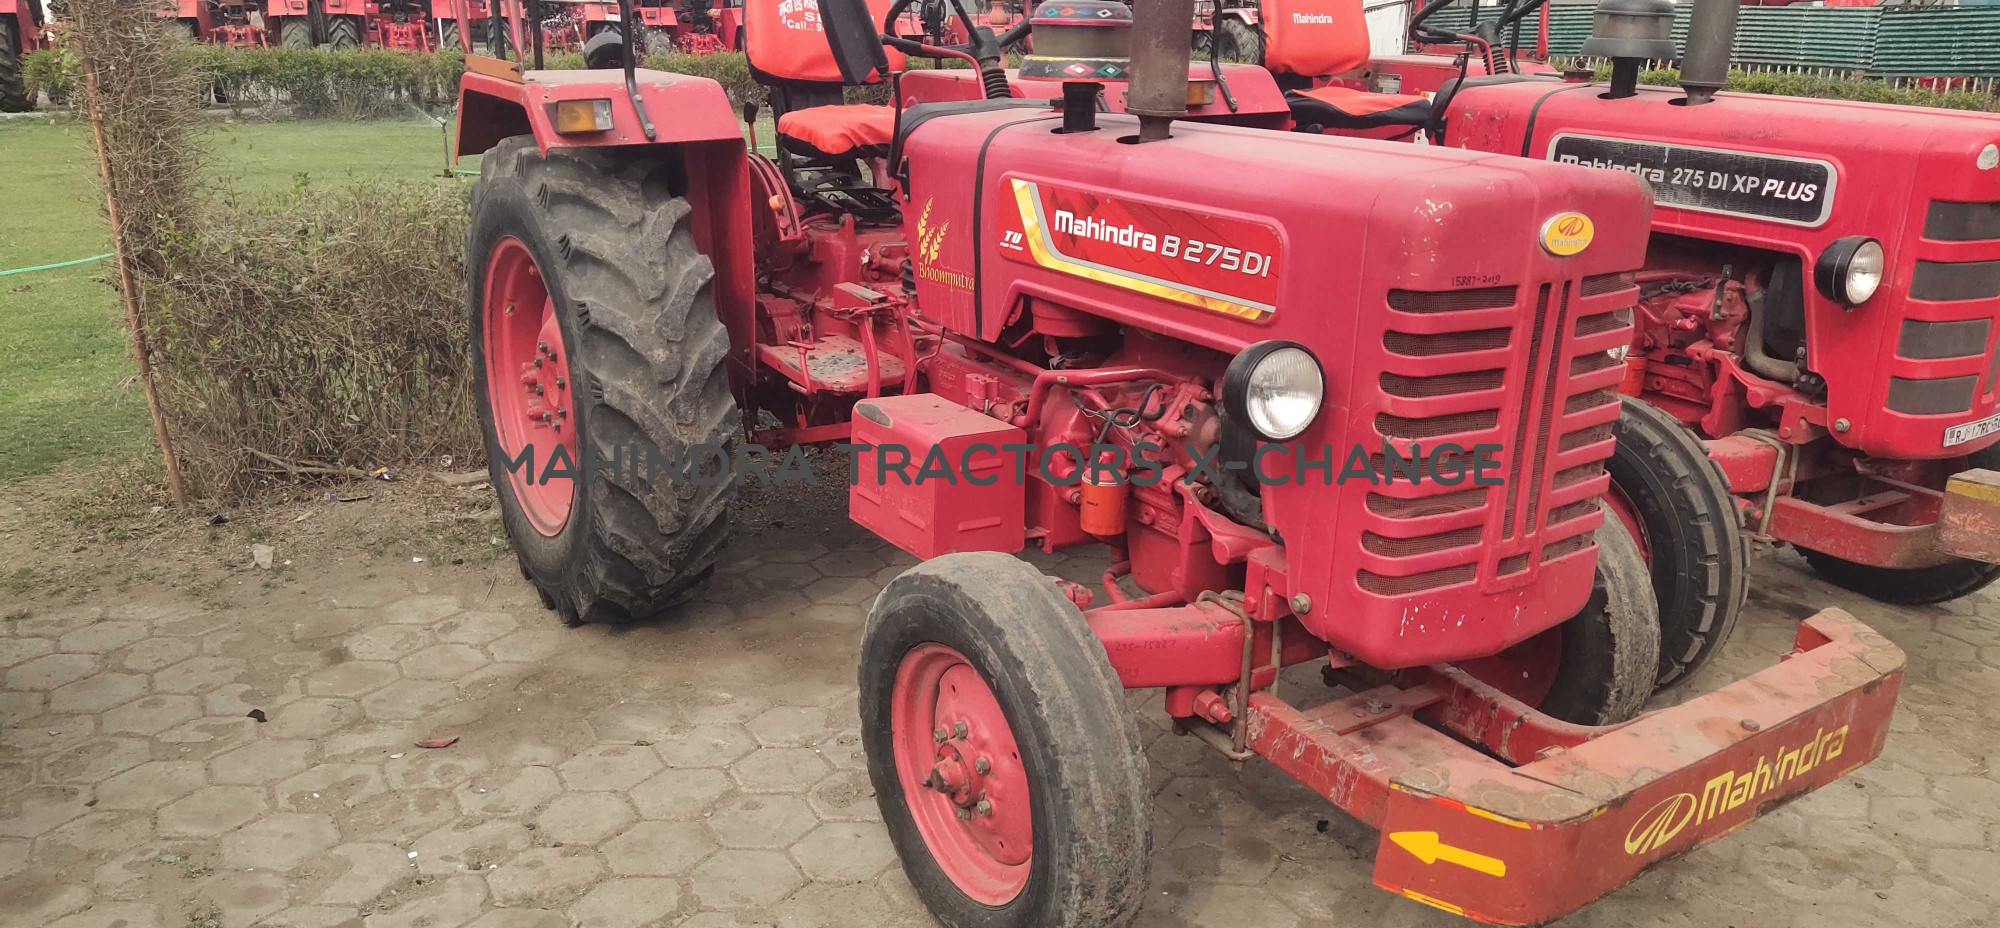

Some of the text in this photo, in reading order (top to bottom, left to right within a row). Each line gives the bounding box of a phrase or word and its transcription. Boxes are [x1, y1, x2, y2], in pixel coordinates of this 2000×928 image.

[1293, 13, 1333, 24] Mahindra
[1671, 168, 1705, 188] 275
[1708, 171, 1727, 191] DI
[1732, 174, 1760, 194] XP
[1761, 179, 1818, 202] PLUS
[1004, 230, 1023, 244] TU
[1055, 209, 1157, 253] Mahindra
[1161, 234, 1181, 258] B
[1696, 724, 1849, 826] Mahindra
